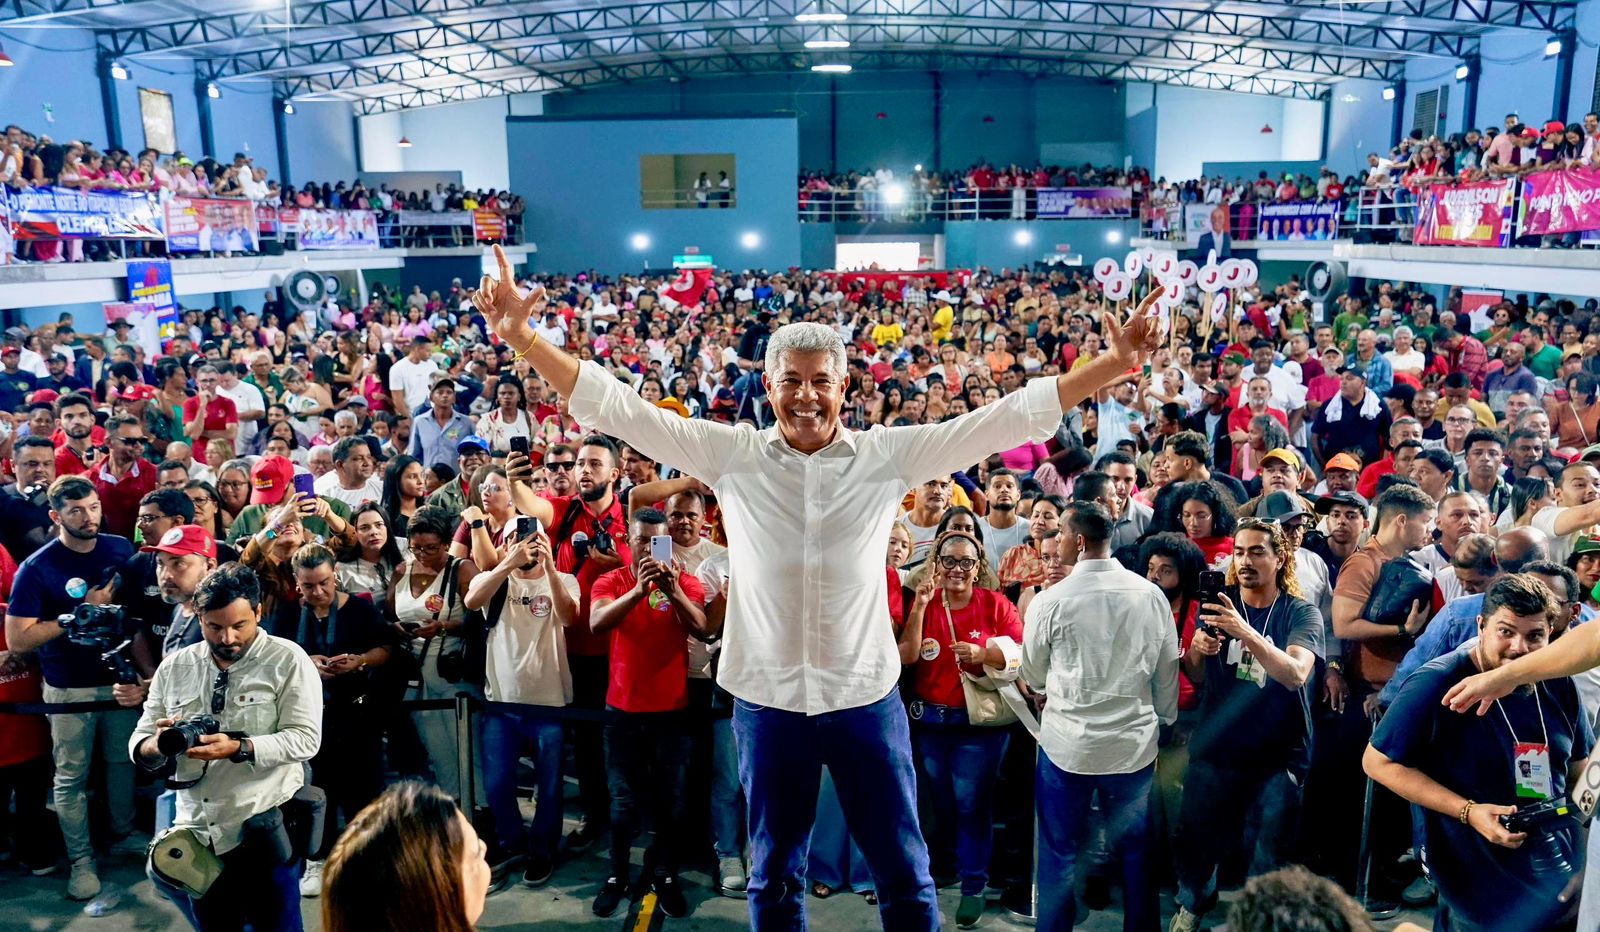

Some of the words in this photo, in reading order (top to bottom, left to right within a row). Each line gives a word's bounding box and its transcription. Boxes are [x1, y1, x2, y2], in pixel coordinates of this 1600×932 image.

[1101, 265, 1112, 276] J
[1161, 260, 1171, 272] J
[1180, 268, 1191, 279] J
[1206, 272, 1217, 284] J
[1227, 267, 1239, 280] J
[1112, 281, 1122, 293] J
[1170, 285, 1178, 299] J
